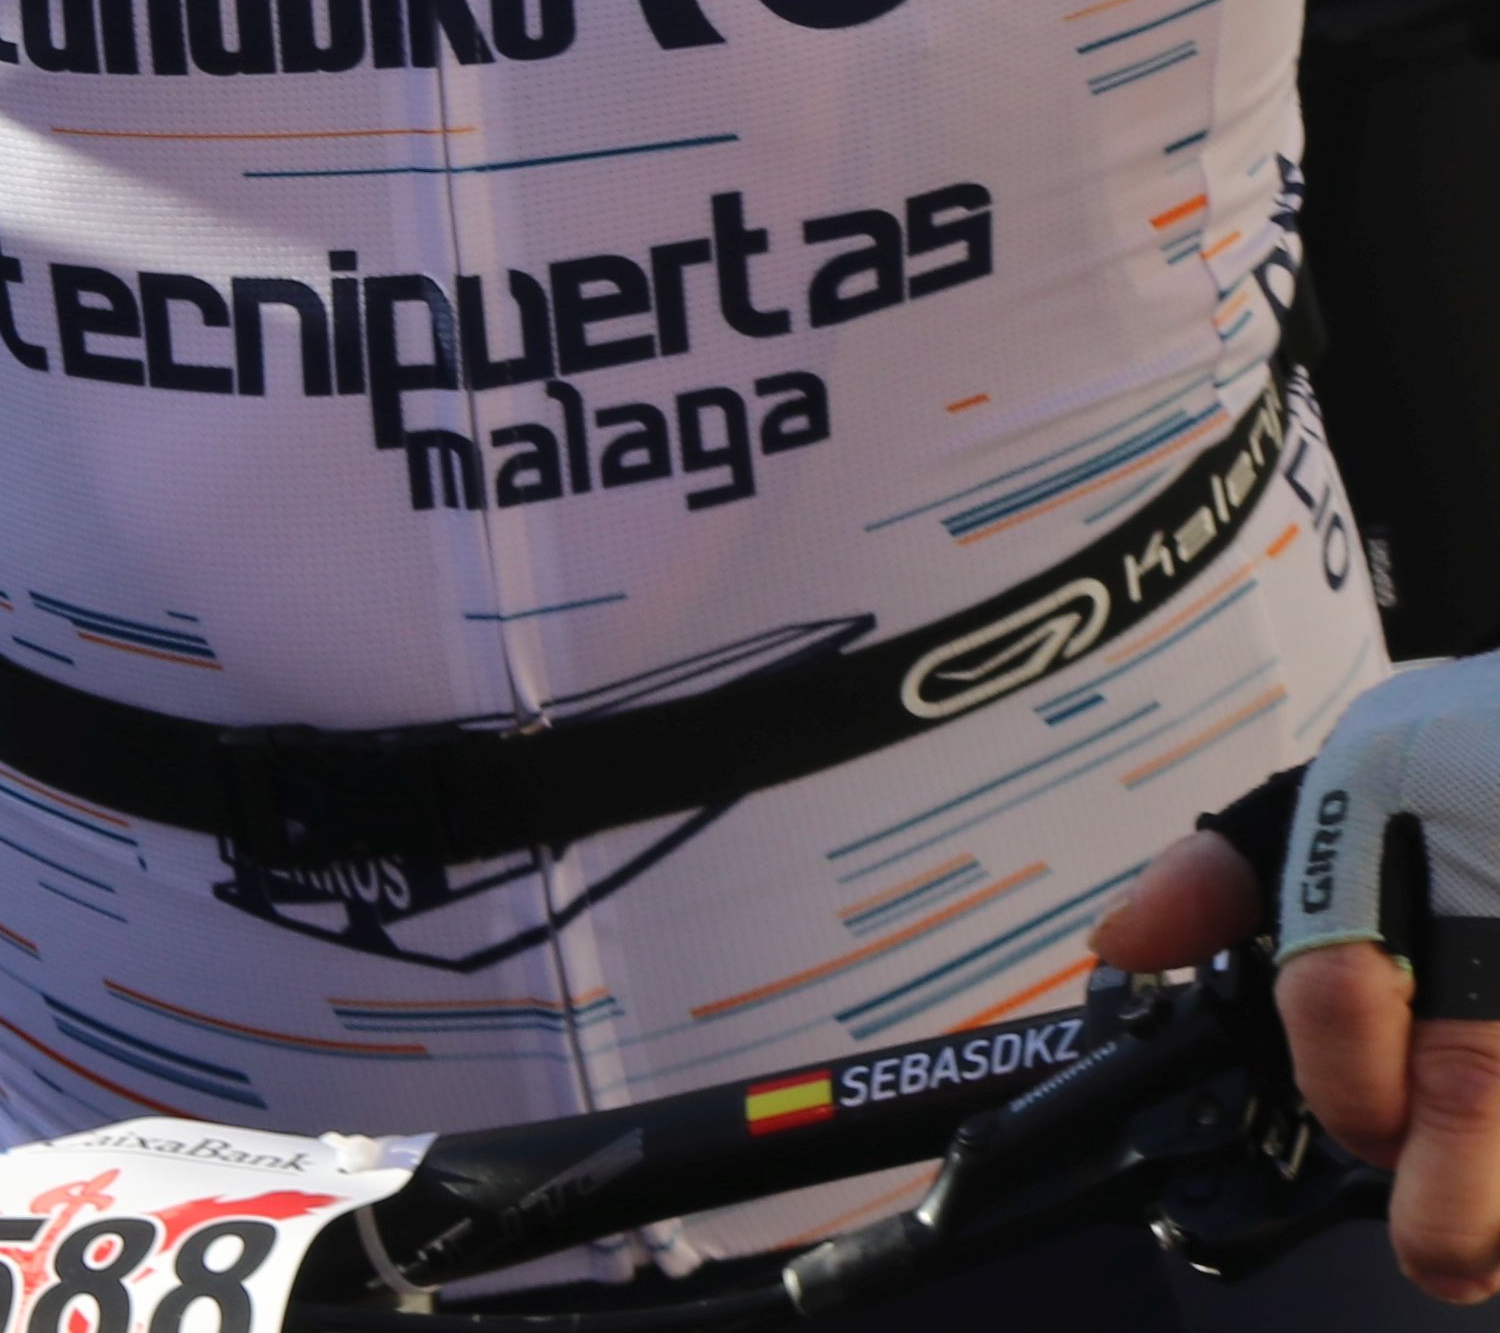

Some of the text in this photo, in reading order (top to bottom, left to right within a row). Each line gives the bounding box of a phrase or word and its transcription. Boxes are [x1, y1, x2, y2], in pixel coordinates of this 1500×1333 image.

[402, 370, 831, 512] malaga
[1300, 788, 1350, 915] GIRO
[839, 1017, 1084, 1107] SEBASDKZ
[76, 1130, 313, 1173] aixaBank
